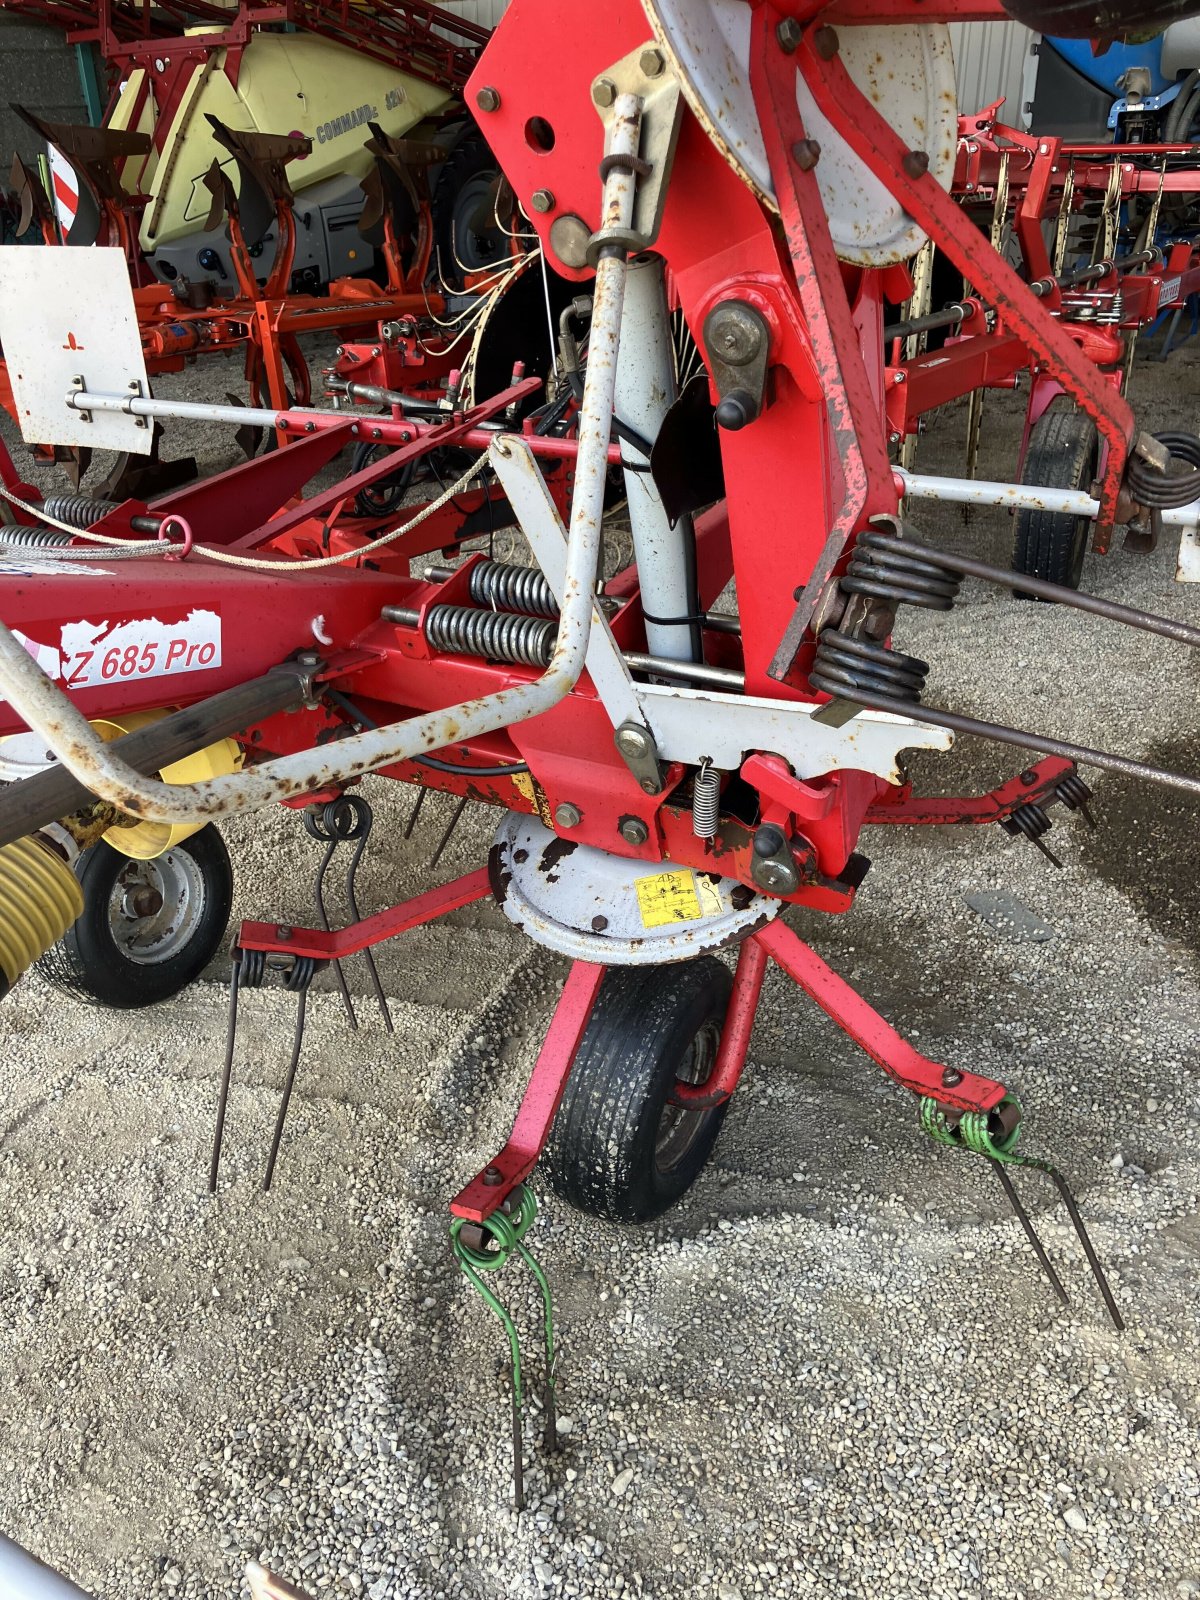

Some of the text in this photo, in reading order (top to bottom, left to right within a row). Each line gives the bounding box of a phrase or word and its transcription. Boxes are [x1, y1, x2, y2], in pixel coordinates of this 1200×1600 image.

[68, 650, 95, 684] Z
[101, 642, 159, 680] 685
[164, 638, 217, 670] Pro
